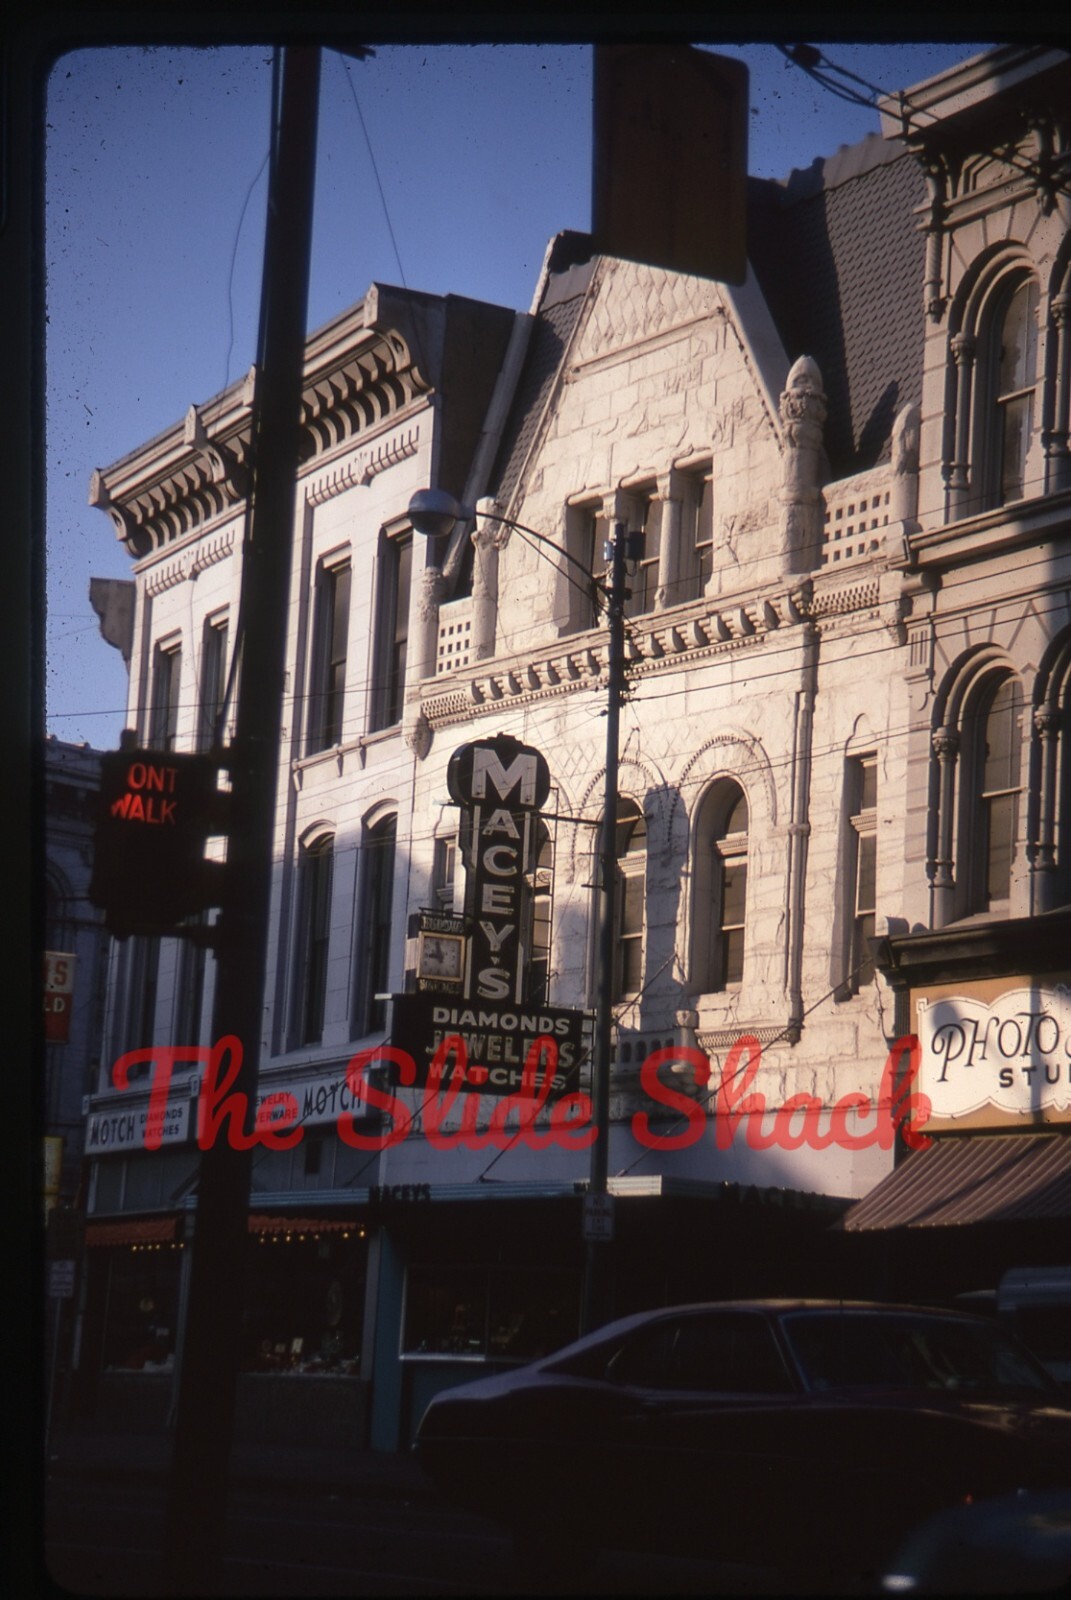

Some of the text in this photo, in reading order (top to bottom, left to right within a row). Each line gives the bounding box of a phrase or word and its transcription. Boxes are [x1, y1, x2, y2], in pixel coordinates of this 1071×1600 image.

[127, 762, 179, 794] ONT
[111, 793, 177, 827] WALK
[432, 1006, 571, 1036] DIAMONDS
[425, 1029, 576, 1068] JEWELERS
[931, 1010, 1060, 1082] PHOTO
[429, 1063, 567, 1091] WATCHES
[999, 1064, 1071, 1088] STU
[256, 1090, 291, 1107] EWELRY
[302, 1078, 362, 1117] MOTCH
[89, 1115, 135, 1147] MOTCH
[140, 1107, 183, 1124] DIAMONDS
[141, 1124, 180, 1138] WATCHES
